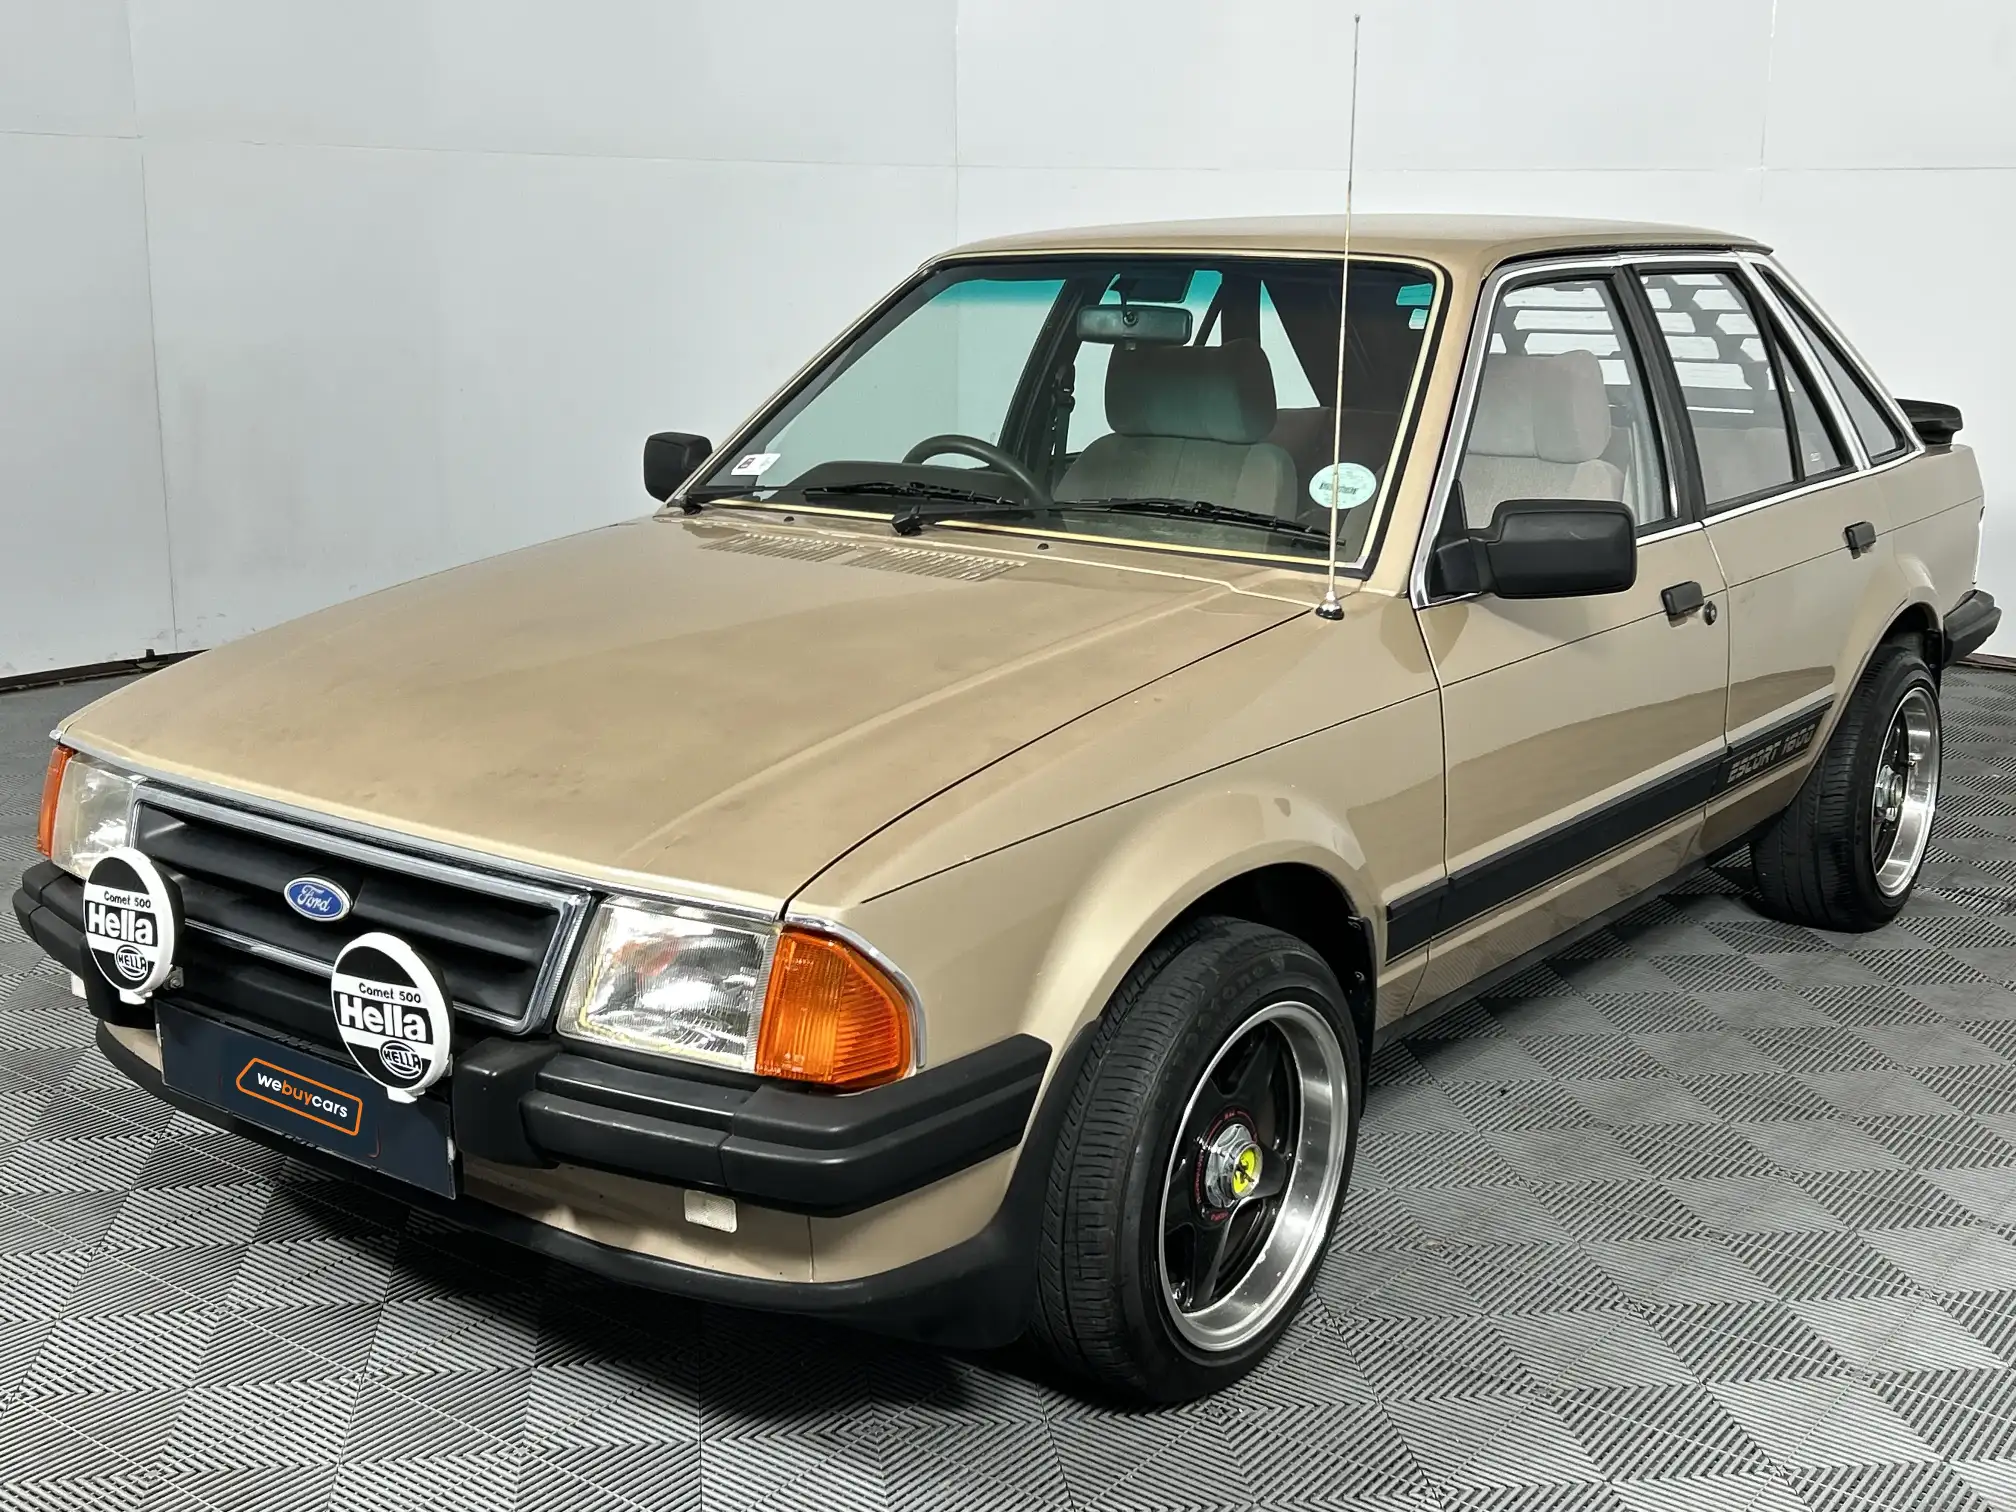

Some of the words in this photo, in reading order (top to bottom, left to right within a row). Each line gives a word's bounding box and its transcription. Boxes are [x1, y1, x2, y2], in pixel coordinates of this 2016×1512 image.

[1727, 740, 1782, 783] ESCORT
[104, 890, 131, 905] Comet
[134, 898, 151, 908] 500
[297, 884, 333, 912] Ford
[88, 902, 153, 945] Hella
[118, 953, 147, 971] HELLA
[358, 982, 394, 1000] Comet
[399, 990, 421, 1003] 500
[340, 993, 426, 1042] Hella
[383, 1048, 420, 1069] HELLA
[257, 1072, 348, 1118] webuycars
